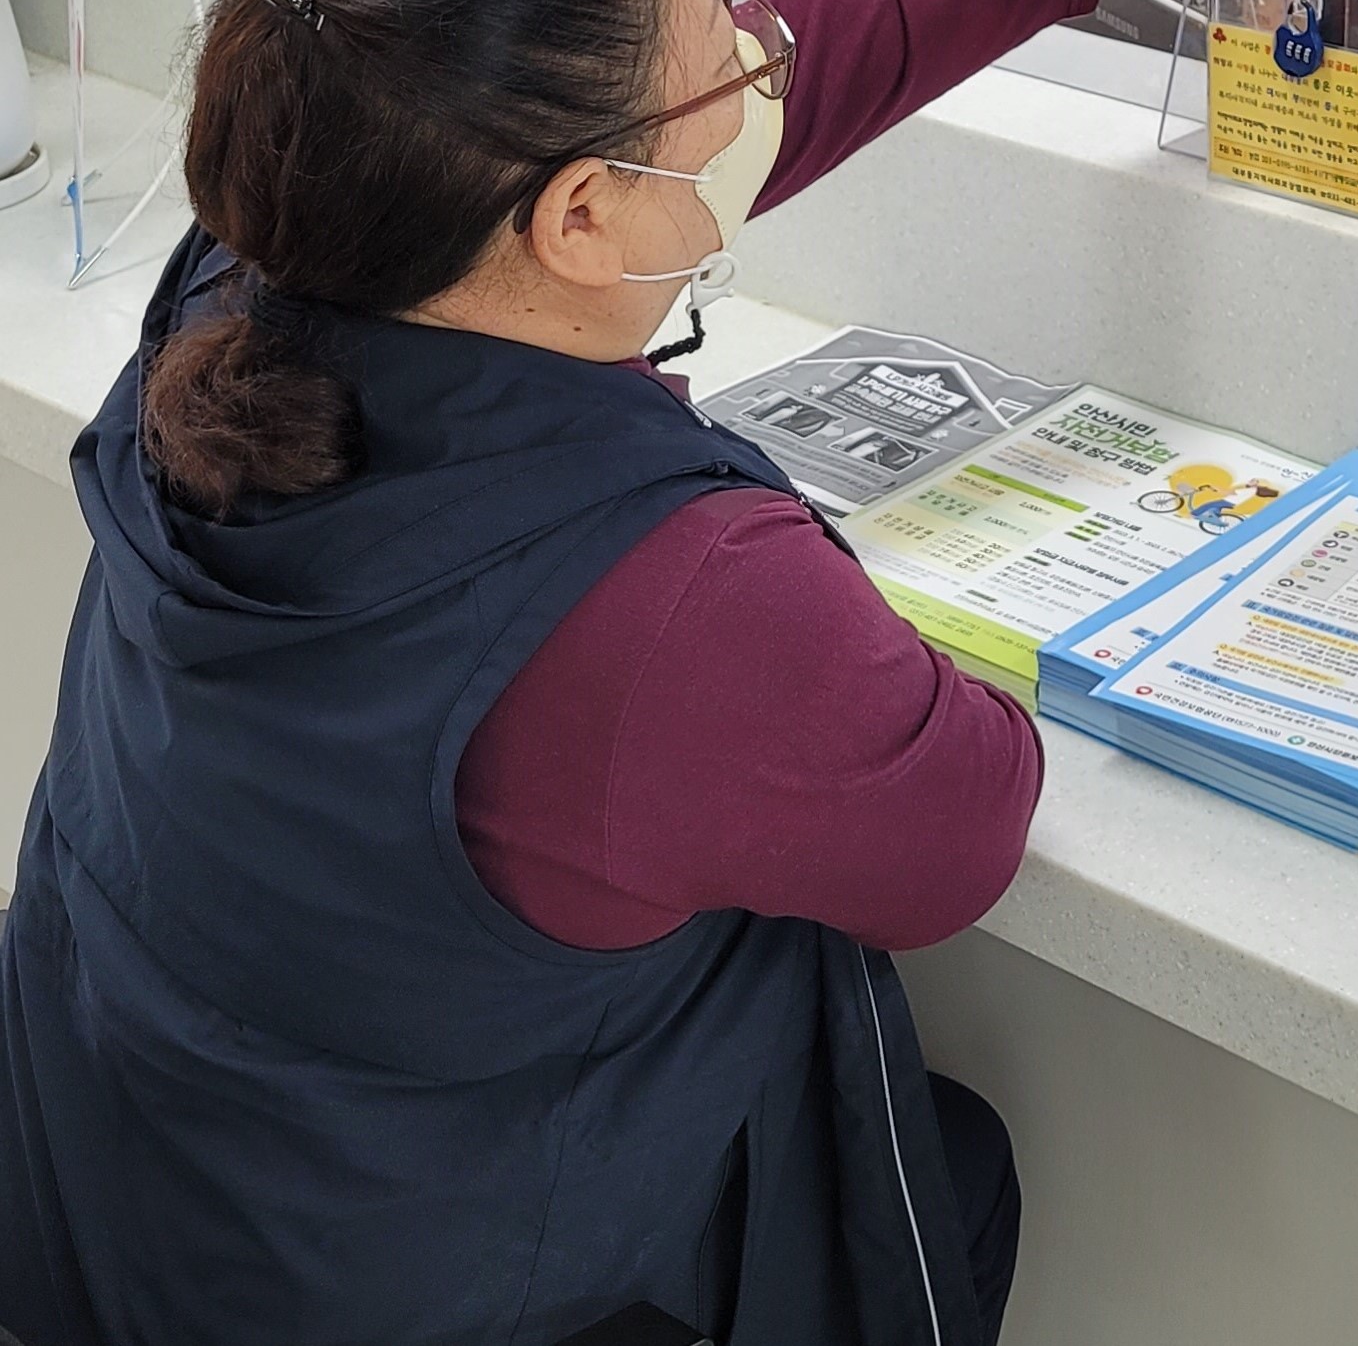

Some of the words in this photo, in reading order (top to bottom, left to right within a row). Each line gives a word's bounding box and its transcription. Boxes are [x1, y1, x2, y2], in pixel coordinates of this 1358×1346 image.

[1046, 407, 1184, 469] 자전거보험
[1070, 401, 1159, 439] 안산시민
[1029, 425, 1070, 447] 안내
[1062, 438, 1089, 453] 및
[1115, 455, 1159, 478] 방법
